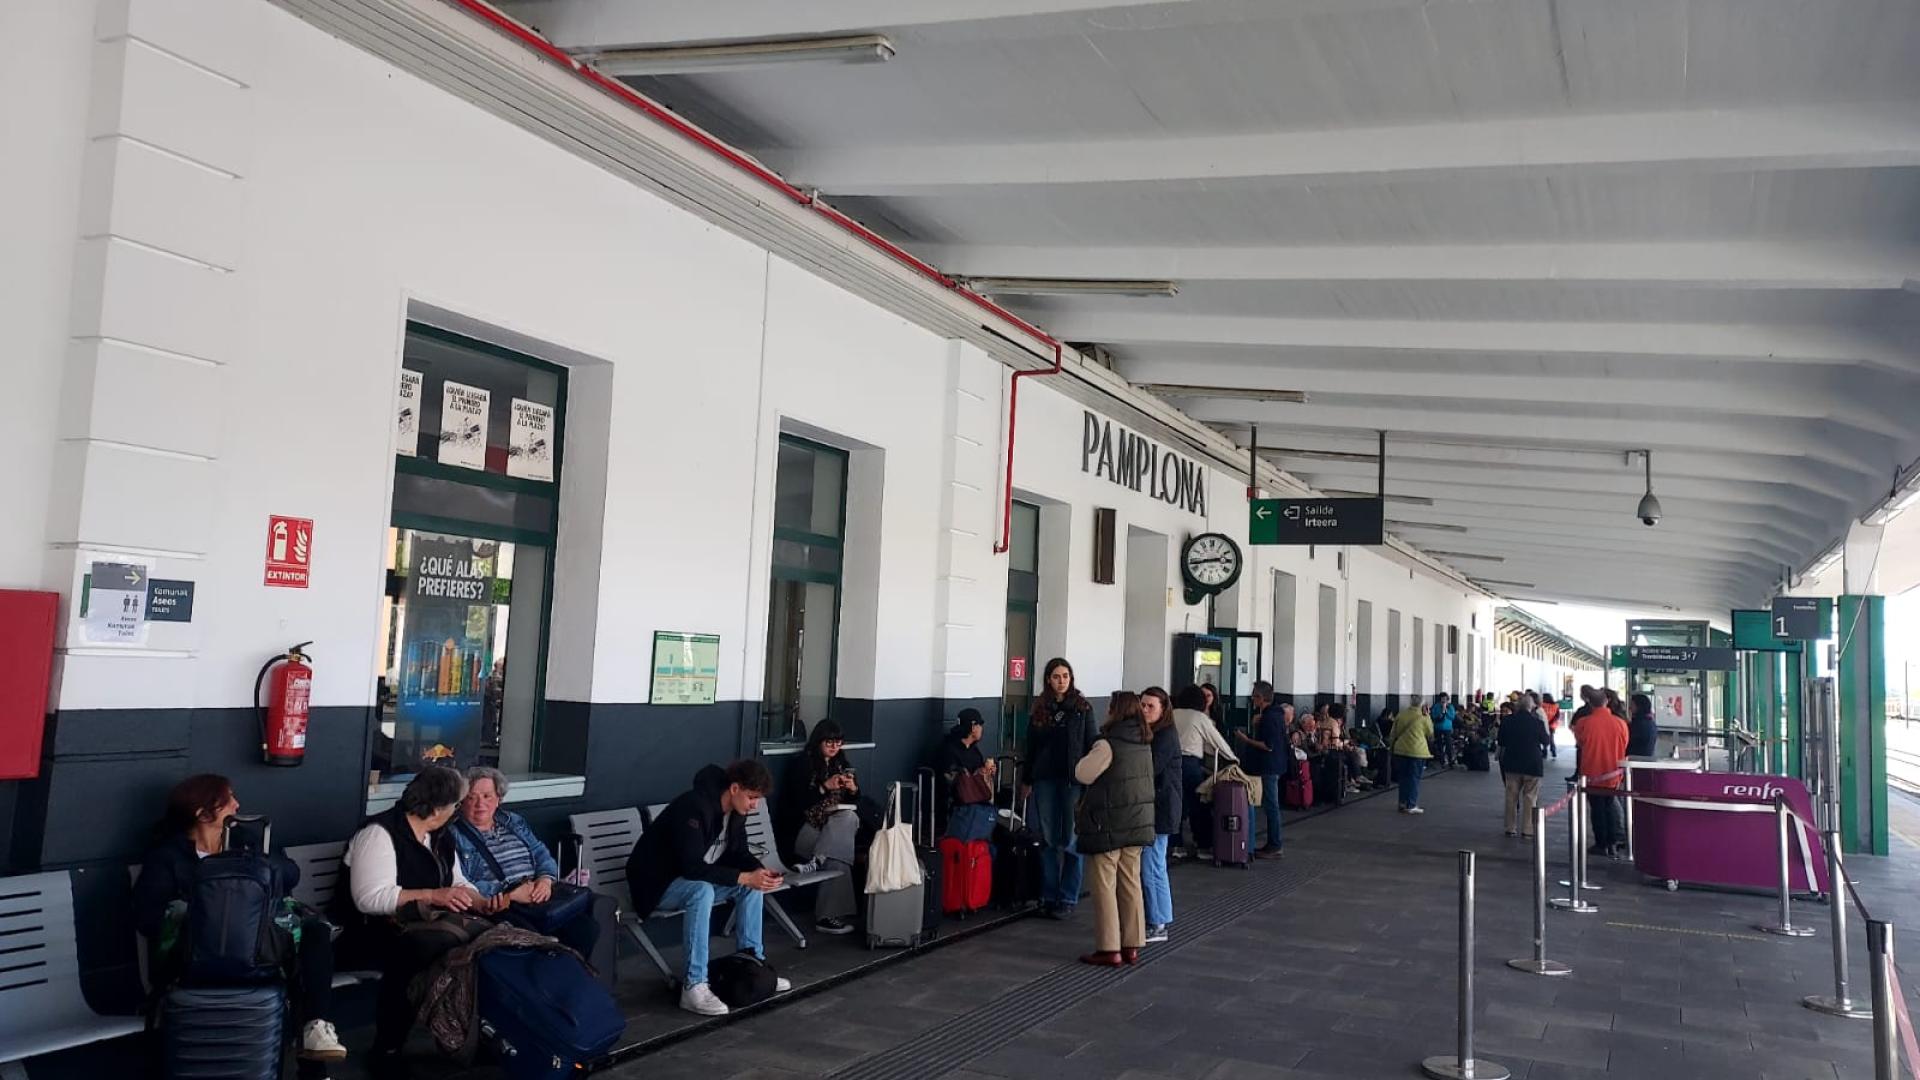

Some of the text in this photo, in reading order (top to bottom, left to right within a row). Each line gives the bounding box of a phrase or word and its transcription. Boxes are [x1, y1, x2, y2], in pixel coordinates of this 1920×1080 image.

[1081, 410, 1206, 517] PAMPLONA
[1305, 505, 1334, 515] Salida
[1305, 517, 1337, 527] Irteera
[420, 554, 484, 579] ¿QUÉ ALAS
[267, 570, 307, 582] EXTINTOR
[417, 576, 485, 600] PREFIERES?
[152, 596, 177, 606] Aseos
[1776, 616, 1789, 637] 1
[1723, 782, 1784, 800] renfe
